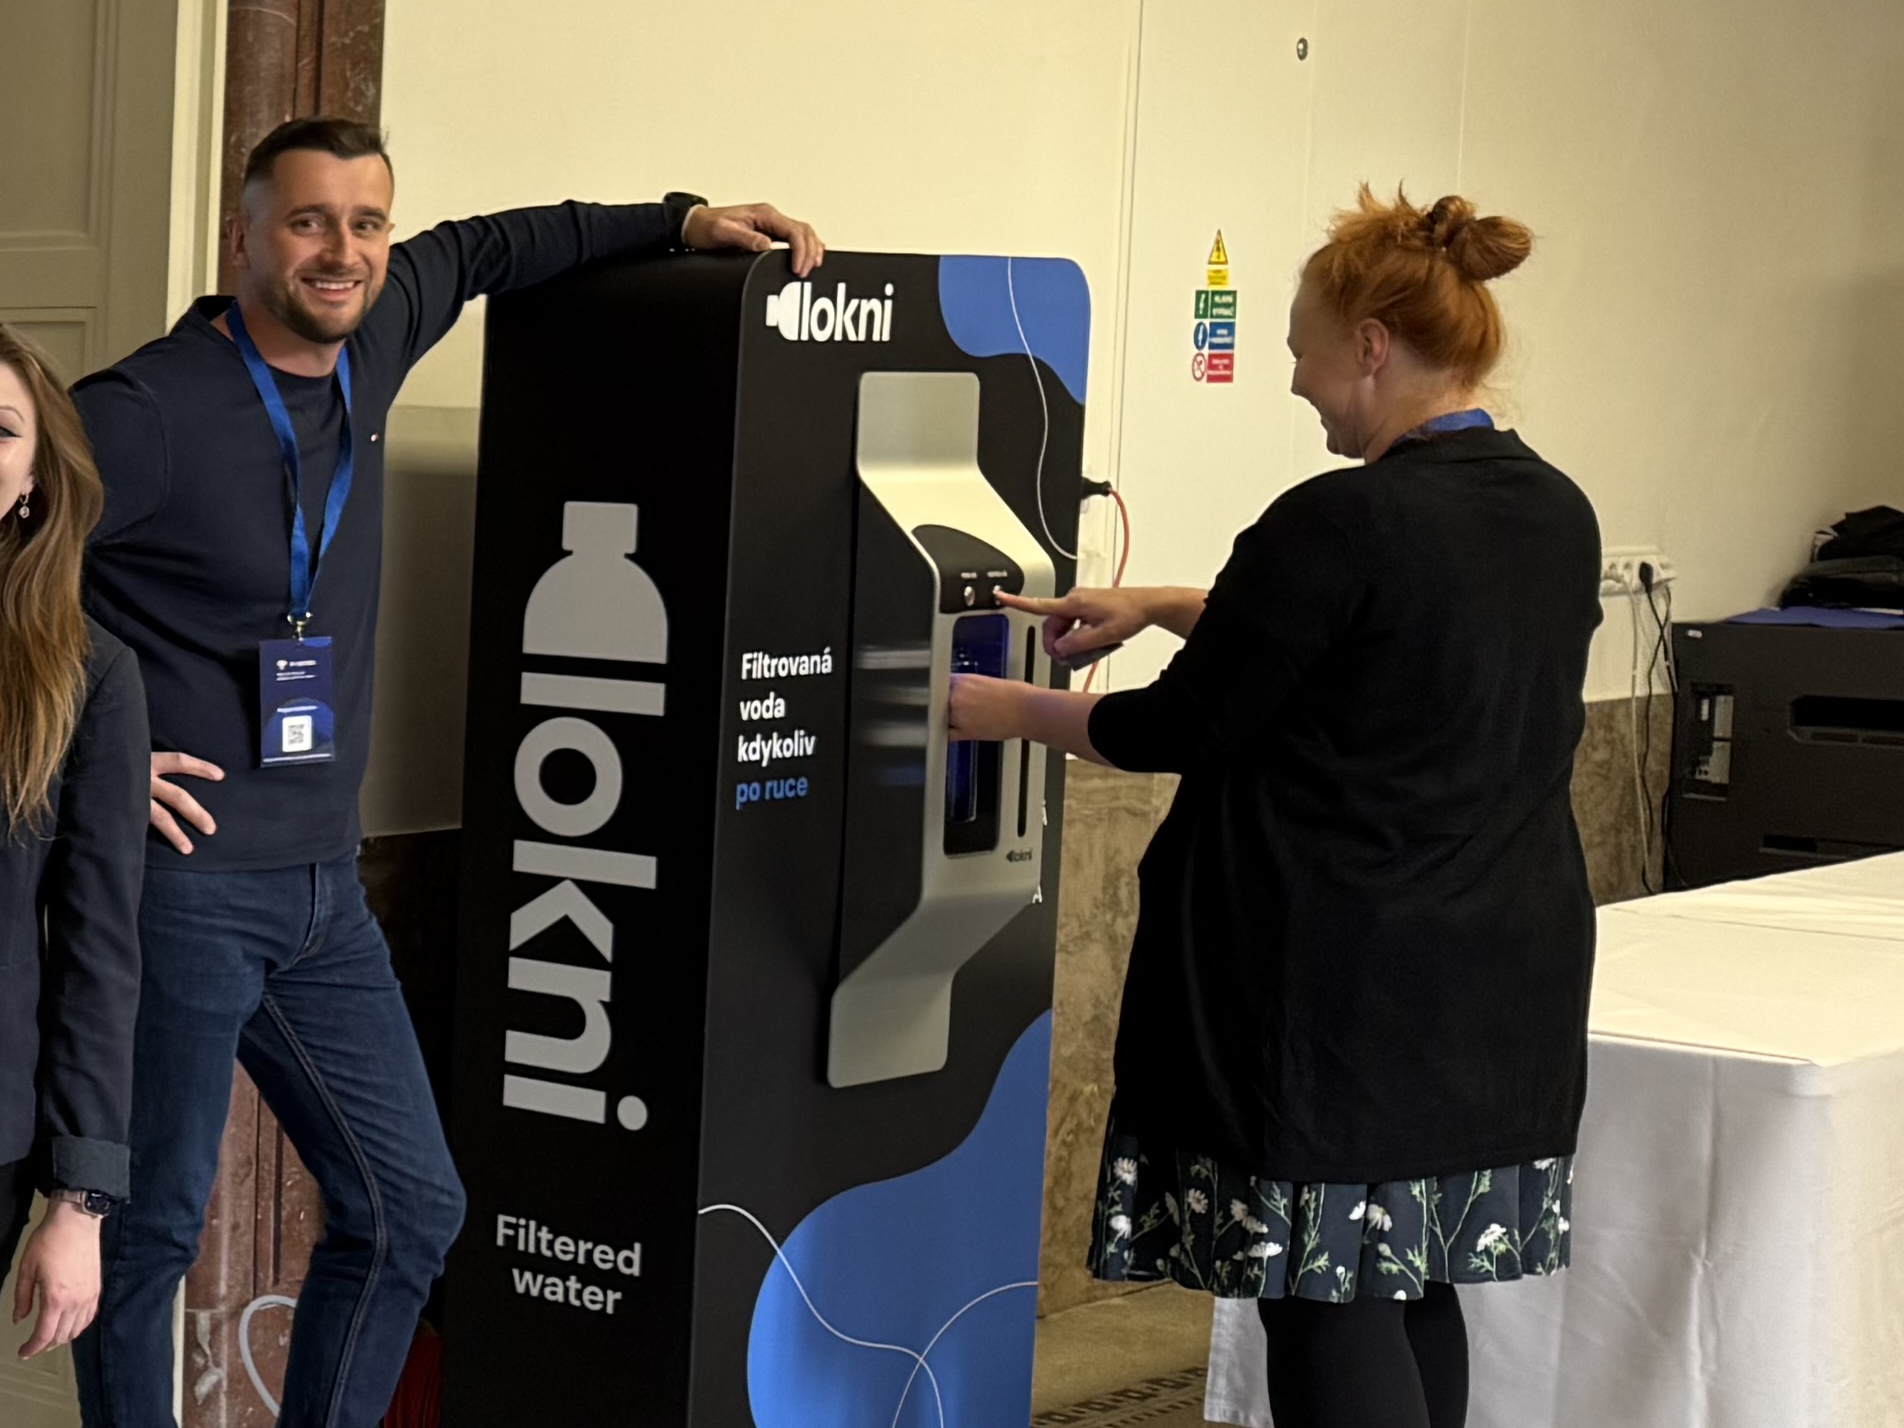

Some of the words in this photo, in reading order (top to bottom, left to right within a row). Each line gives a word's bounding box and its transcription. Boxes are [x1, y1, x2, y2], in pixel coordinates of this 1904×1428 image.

[800, 281, 894, 342] lokni
[741, 646, 833, 681] Filtrovaná
[739, 691, 786, 721] voda
[737, 729, 817, 768] kdykoliv
[736, 781, 761, 810] po
[765, 777, 809, 801] ruce
[502, 671, 666, 1132] lokni
[495, 1213, 642, 1278] Filtered
[511, 1267, 623, 1315] water
